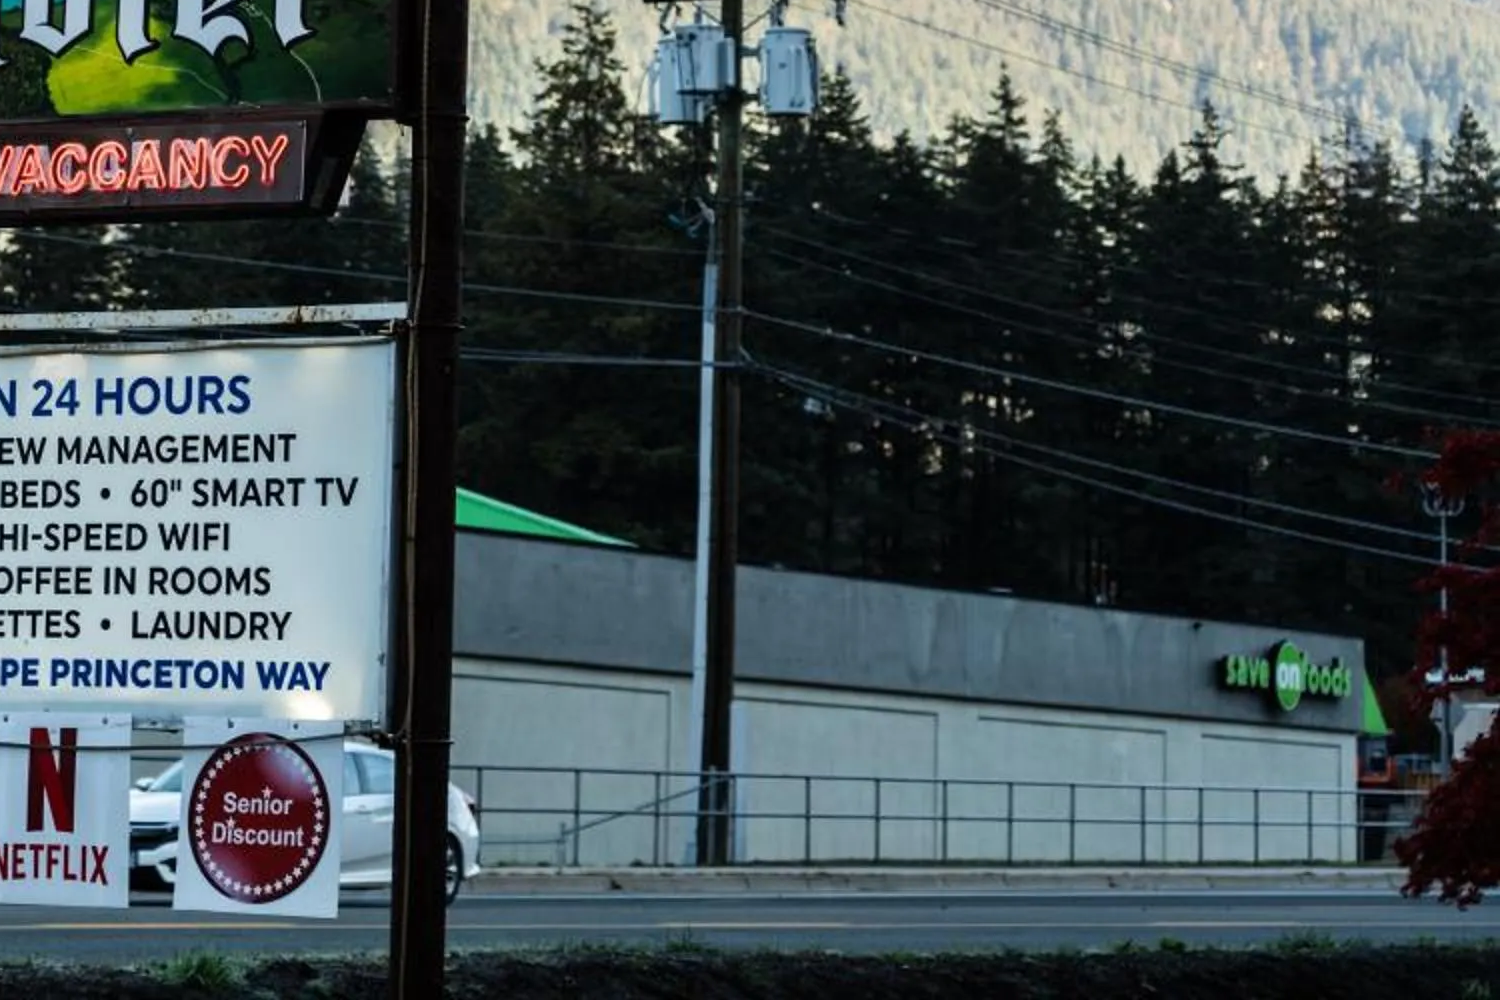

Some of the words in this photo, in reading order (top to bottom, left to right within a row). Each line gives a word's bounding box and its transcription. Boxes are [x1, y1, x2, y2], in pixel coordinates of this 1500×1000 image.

[31, 379, 80, 417] 24
[95, 375, 252, 415] HOURS
[57, 433, 297, 464] MANAGEMENT
[0, 480, 81, 509] BEDS
[131, 478, 182, 507] 60"
[192, 478, 306, 507] SMART
[315, 477, 359, 507] TV
[158, 522, 230, 551] WIFI
[104, 566, 137, 594] IN
[149, 565, 271, 595] ROOMS
[131, 610, 292, 640] LAUNDRY
[50, 659, 246, 689] PRINCETON
[257, 661, 331, 691] WAY
[1226, 653, 1270, 689] save
[1276, 661, 1300, 690] on
[1299, 650, 1352, 698] foods
[222, 790, 293, 816] Senior
[211, 820, 304, 847] Discount
